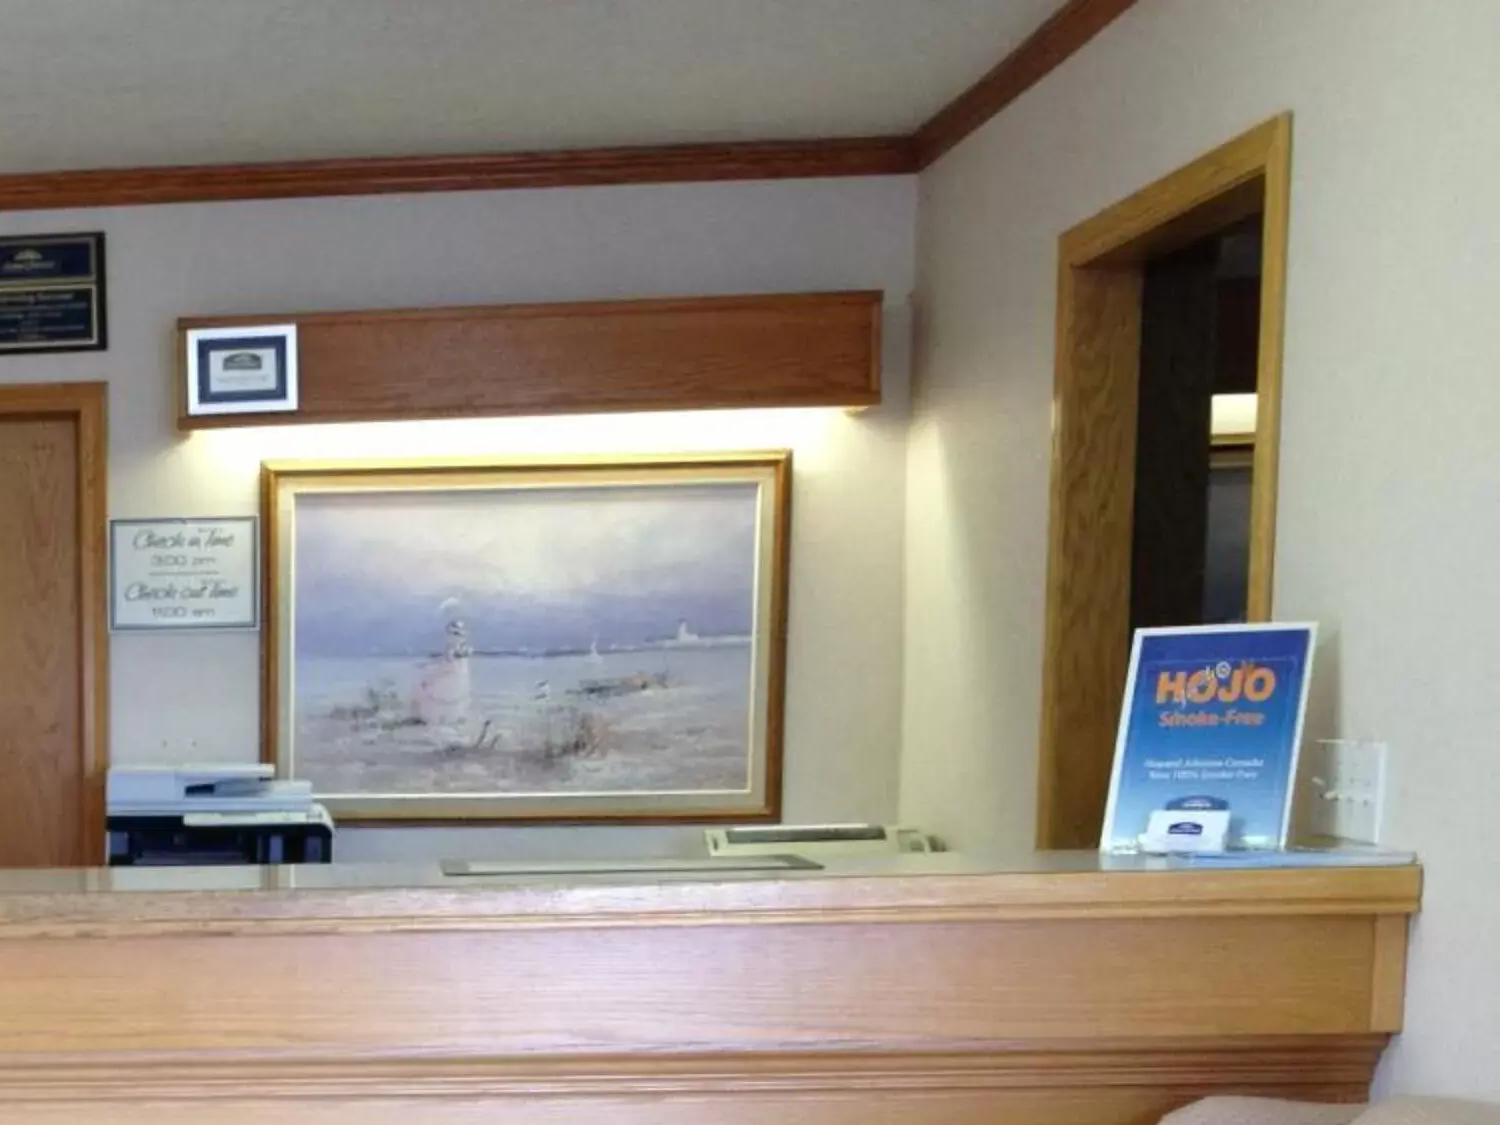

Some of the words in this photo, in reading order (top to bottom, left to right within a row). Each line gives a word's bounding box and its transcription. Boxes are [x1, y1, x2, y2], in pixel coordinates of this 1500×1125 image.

[132, 526, 187, 551] Check
[124, 581, 178, 602] Check
[1156, 664, 1276, 704] HOJO
